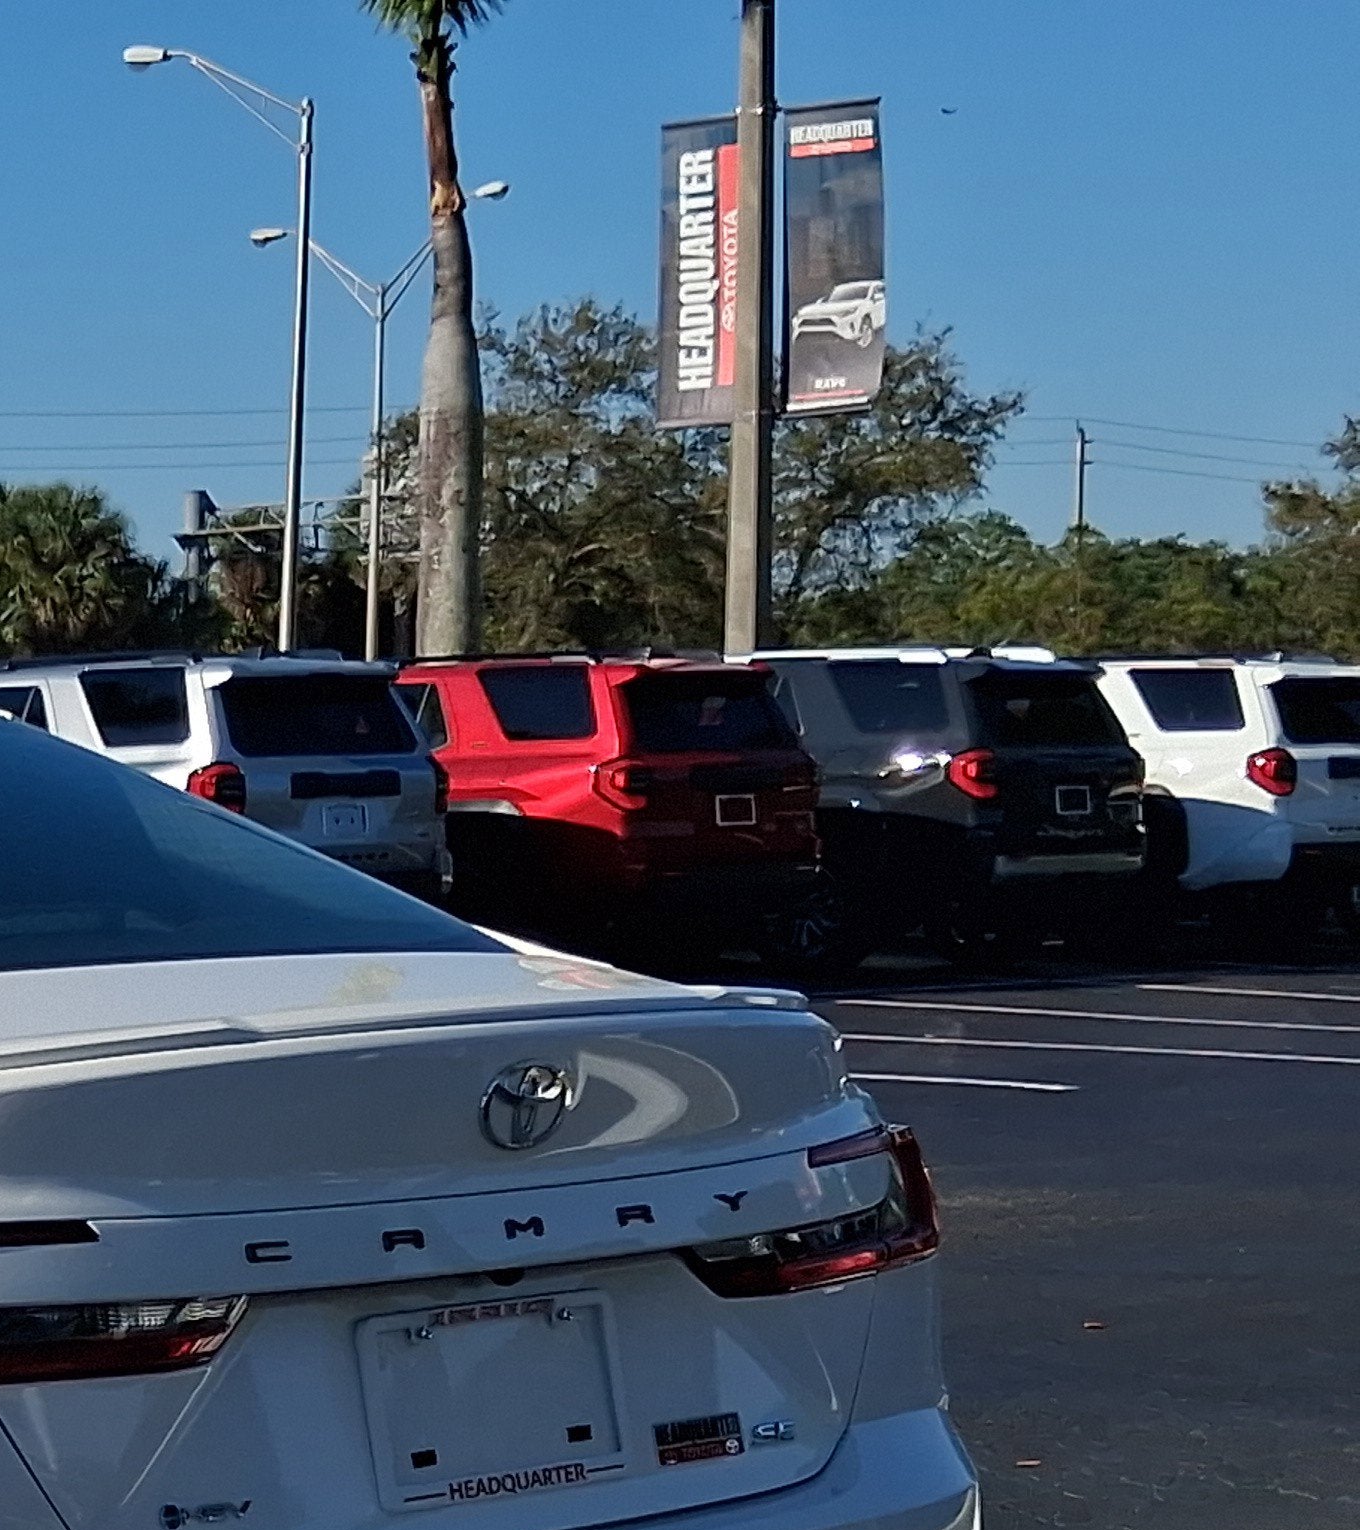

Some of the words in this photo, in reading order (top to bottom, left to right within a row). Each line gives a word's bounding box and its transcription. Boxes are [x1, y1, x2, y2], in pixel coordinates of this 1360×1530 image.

[678, 149, 719, 392] HEADQUARTER
[722, 208, 739, 303] TOYOTA
[244, 1190, 750, 1264] CAMRY
[448, 1462, 588, 1500] HEADQUARTER
